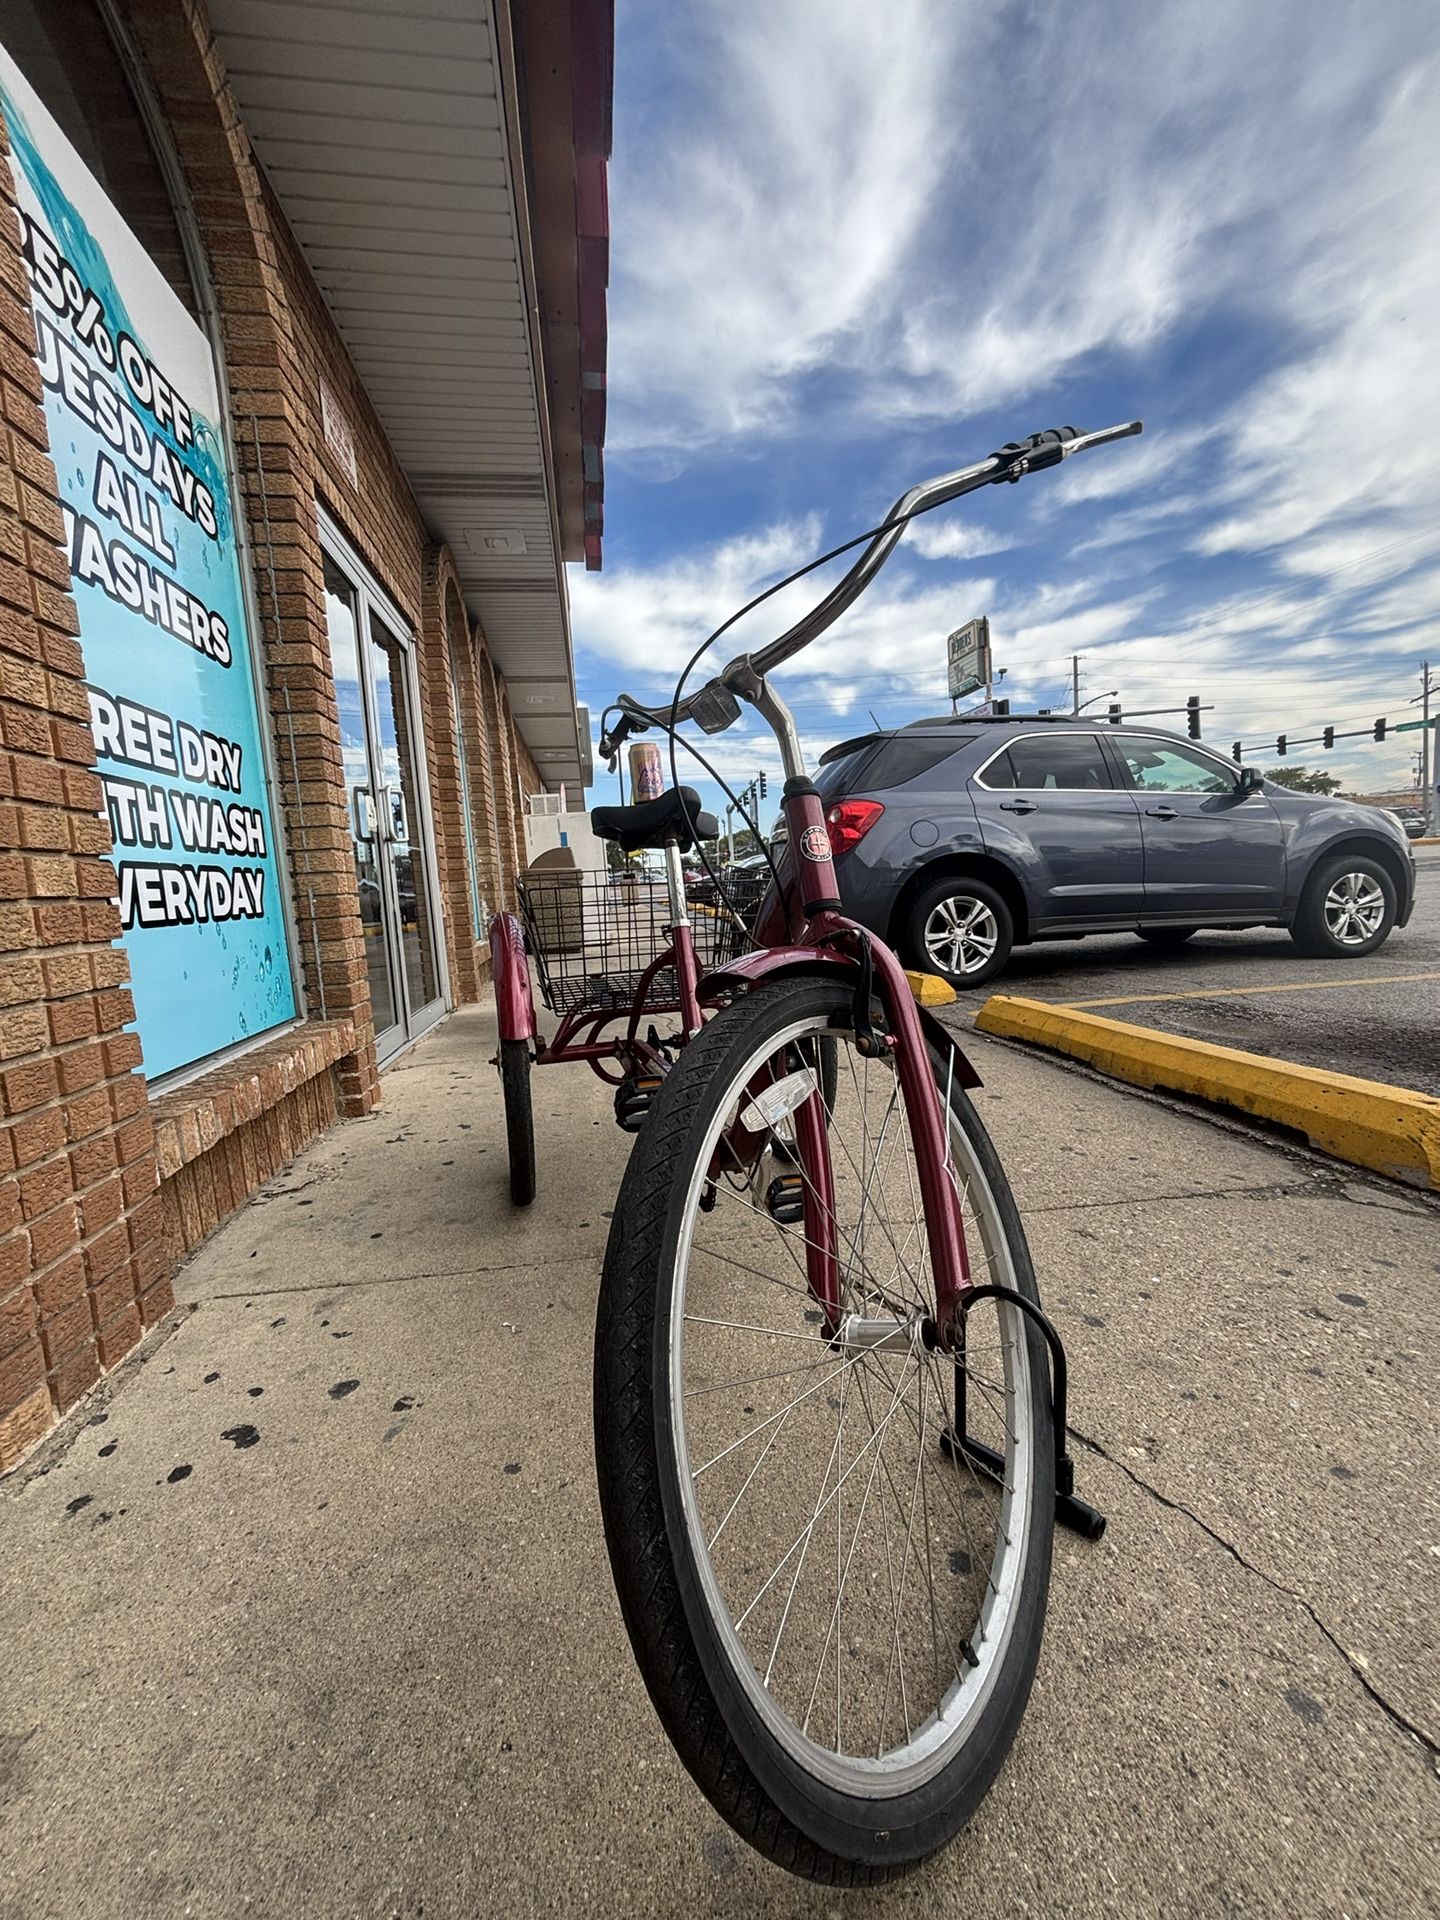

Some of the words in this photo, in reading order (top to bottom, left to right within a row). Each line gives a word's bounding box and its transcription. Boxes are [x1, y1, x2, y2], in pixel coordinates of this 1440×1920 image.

[31, 311, 218, 540] UESDAYS
[117, 331, 194, 453] OFF
[94, 450, 176, 568] ALL
[84, 683, 179, 777] REE
[177, 720, 242, 794] DRY
[168, 789, 267, 858] WASH
[108, 860, 264, 930] VERYDAY
